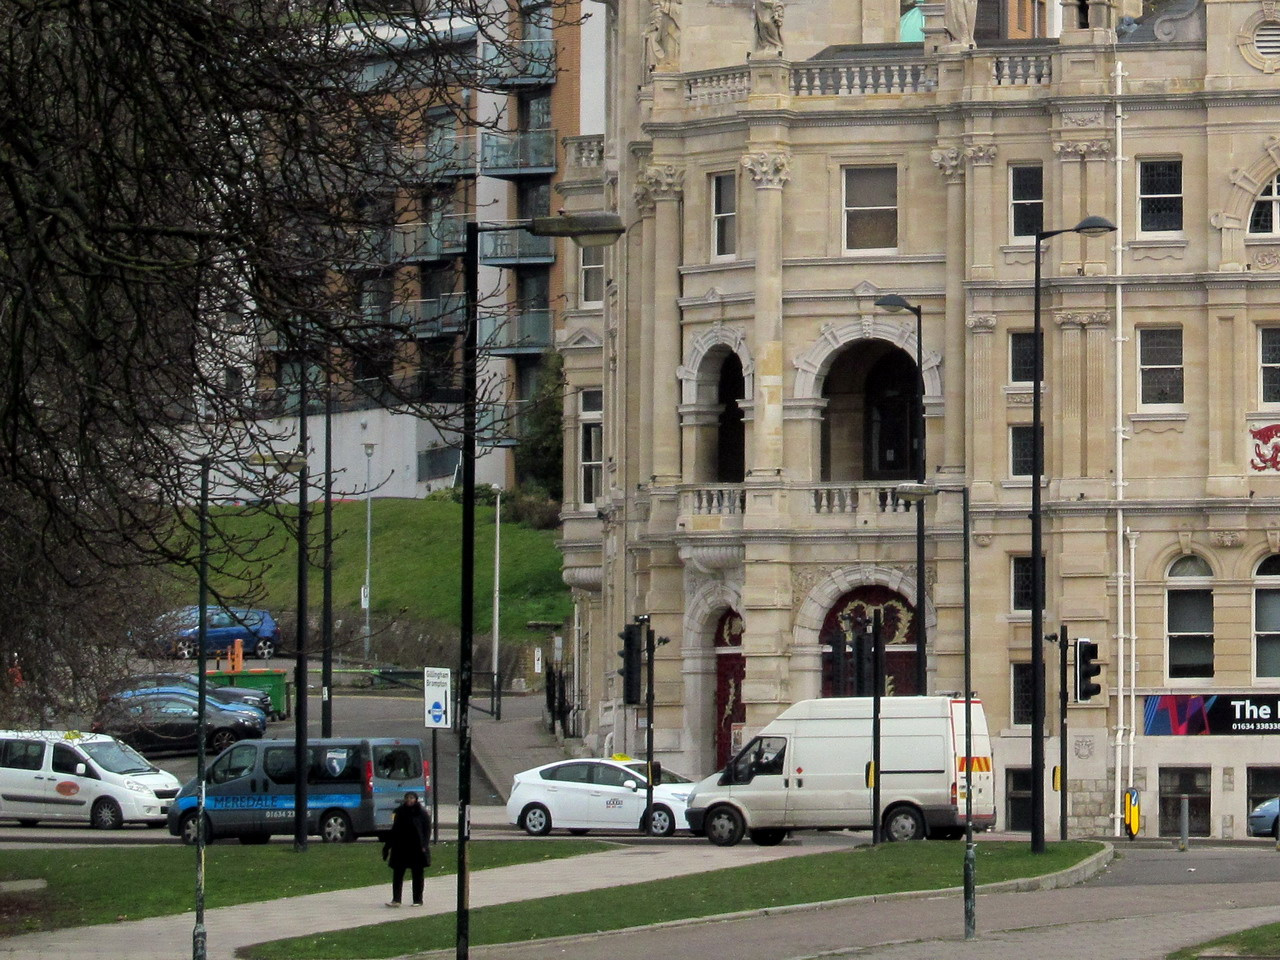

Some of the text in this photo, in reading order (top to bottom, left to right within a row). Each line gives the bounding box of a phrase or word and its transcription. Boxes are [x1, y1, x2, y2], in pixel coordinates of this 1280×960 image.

[426, 670, 449, 679] Gillingham
[1231, 699, 1271, 719] The
[214, 795, 278, 809] MEREDALE
[265, 810, 286, 818] 01634
